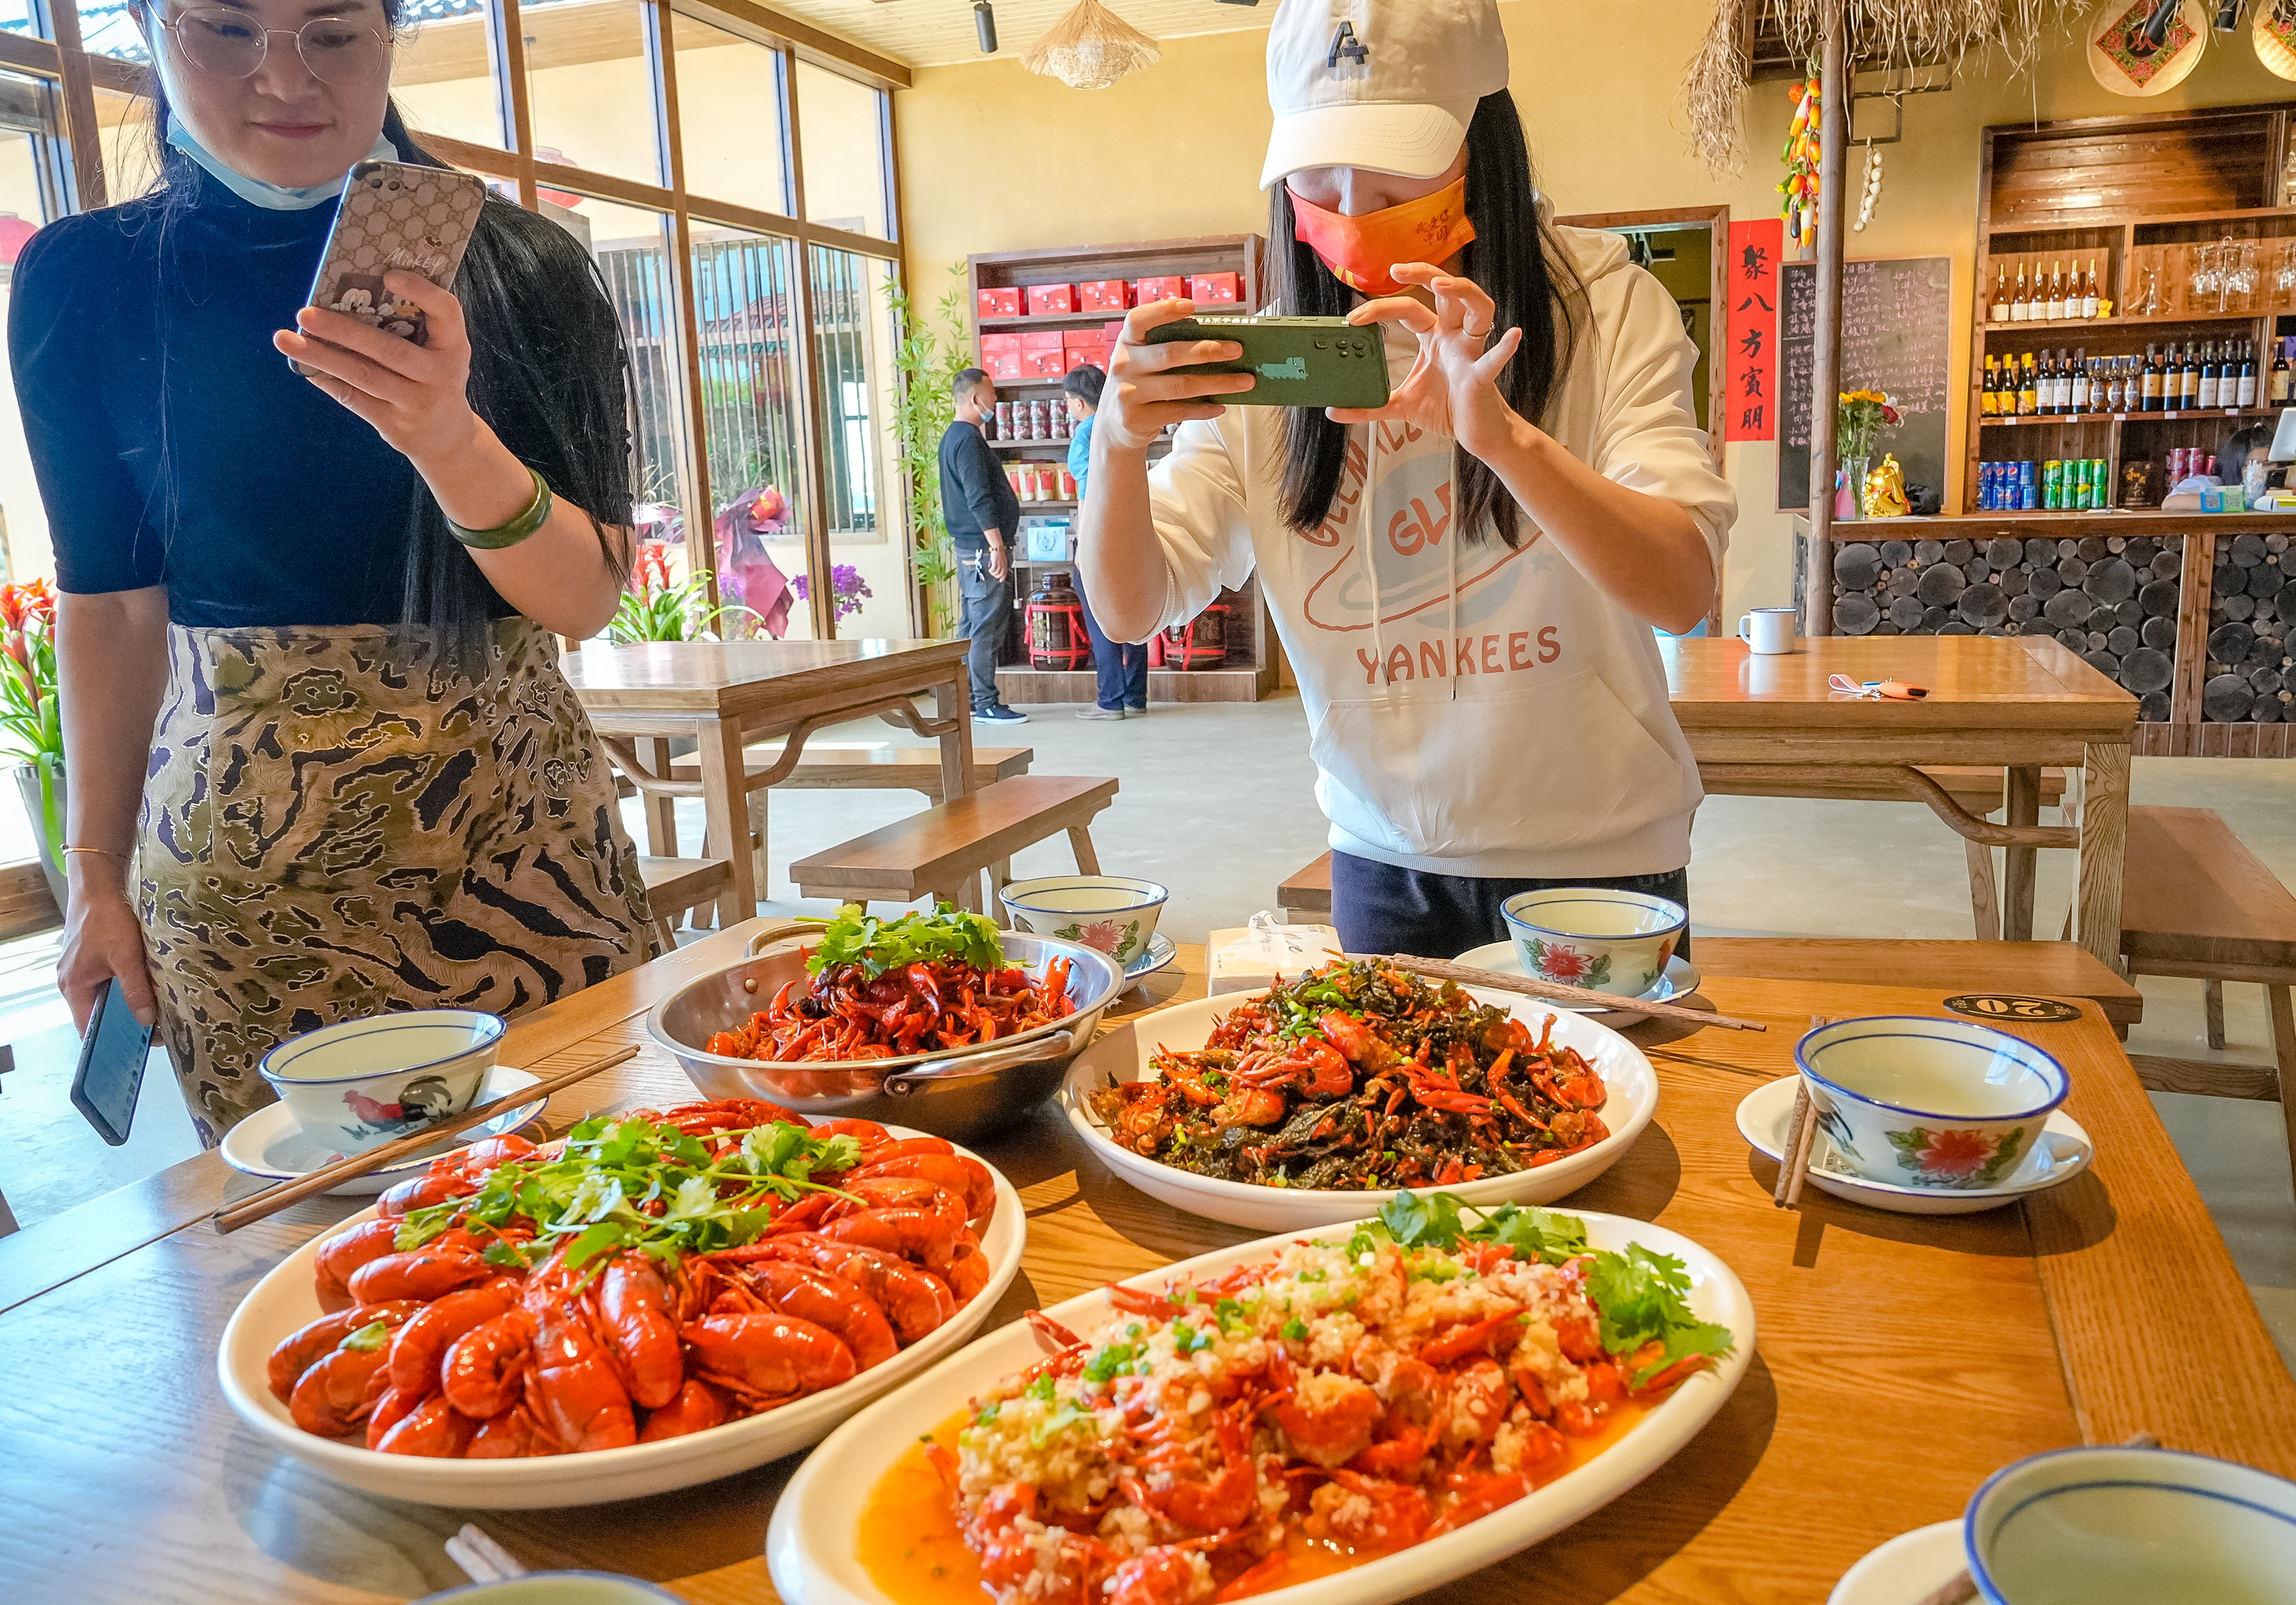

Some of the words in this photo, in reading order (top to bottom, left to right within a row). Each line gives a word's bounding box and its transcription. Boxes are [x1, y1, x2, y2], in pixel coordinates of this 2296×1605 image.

[1327, 20, 1370, 68] A
[1423, 225, 1448, 246] 中国
[1388, 481, 1452, 557] GL
[1357, 625, 1562, 684] YANKEES
[1976, 999, 2045, 1016] 20
